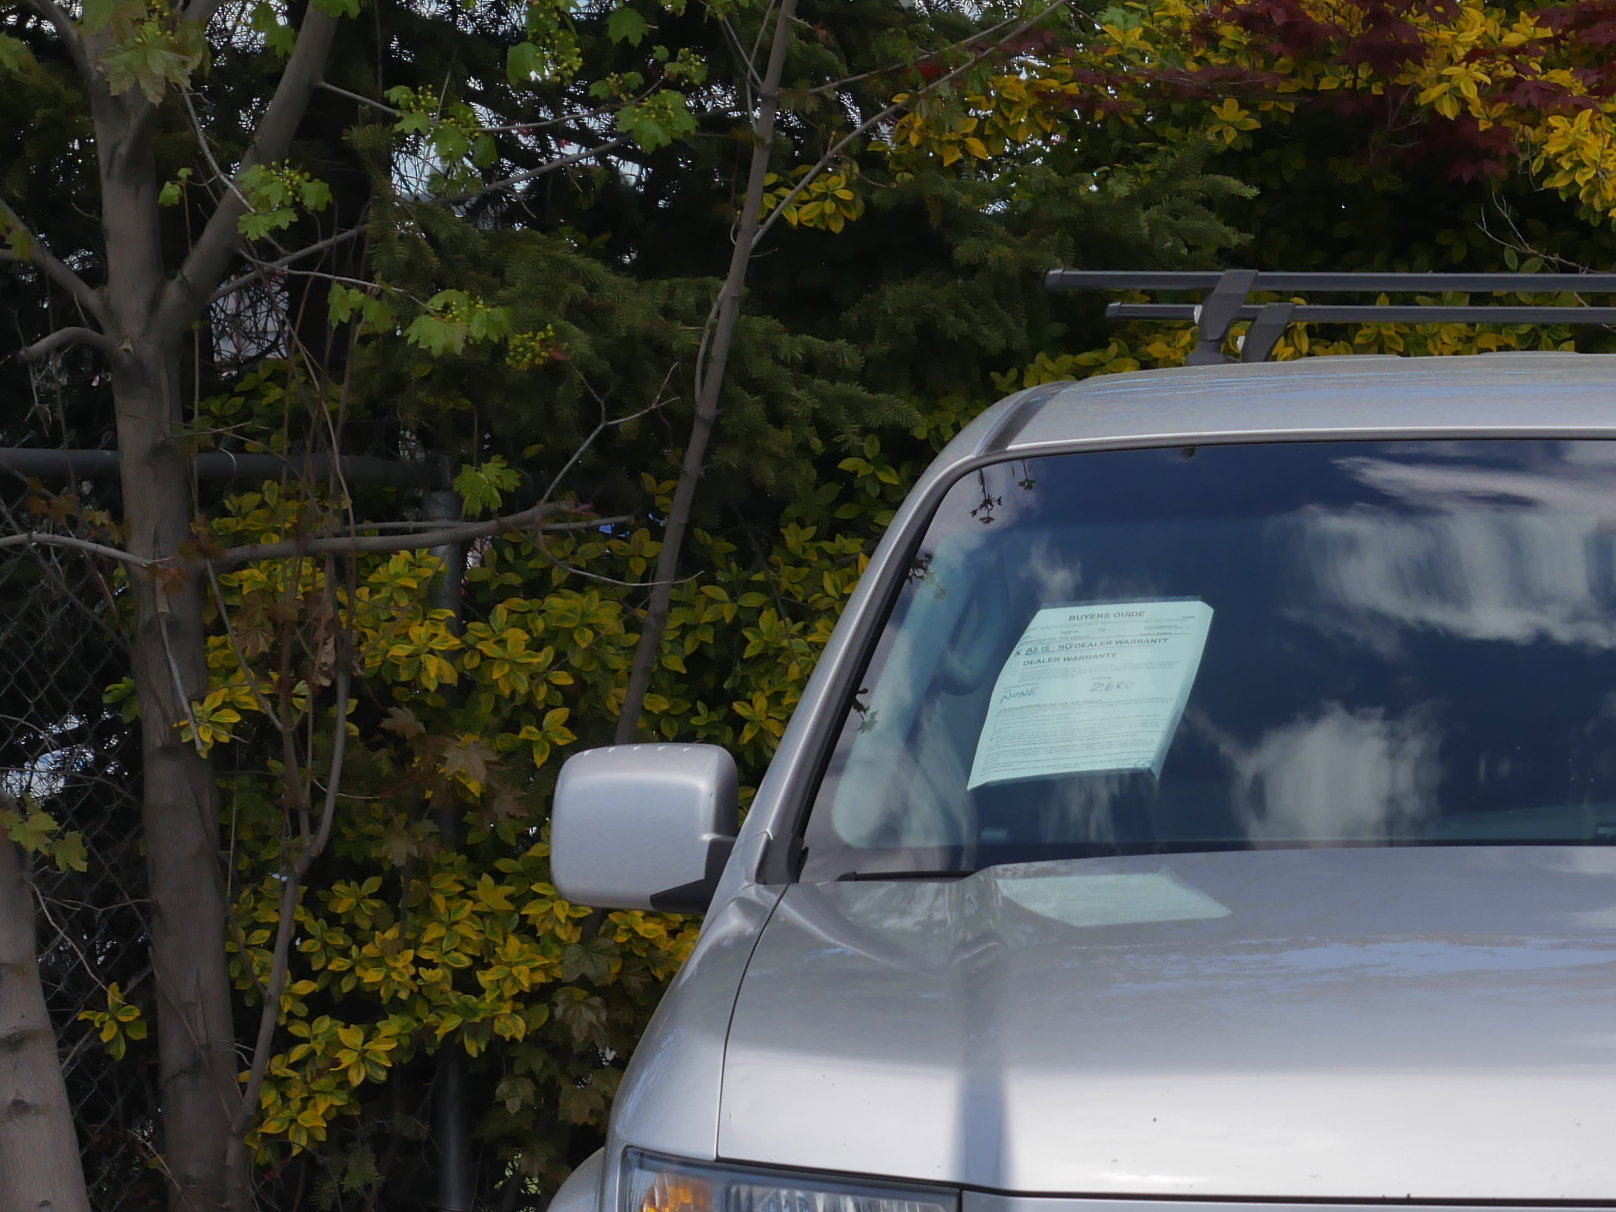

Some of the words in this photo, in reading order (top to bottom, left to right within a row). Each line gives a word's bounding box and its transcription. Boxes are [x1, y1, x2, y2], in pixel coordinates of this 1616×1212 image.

[1068, 611, 1110, 622] BUYERS
[1112, 610, 1146, 619] GUIDE
[1040, 644, 1050, 653] IS
[1058, 642, 1073, 651] NO
[1074, 639, 1114, 650] DEALER
[1115, 637, 1170, 647] WARRANTY
[1022, 655, 1061, 667] DEALER
[1063, 652, 1118, 663] WARRANTY
[1089, 680, 1135, 692] ZERO
